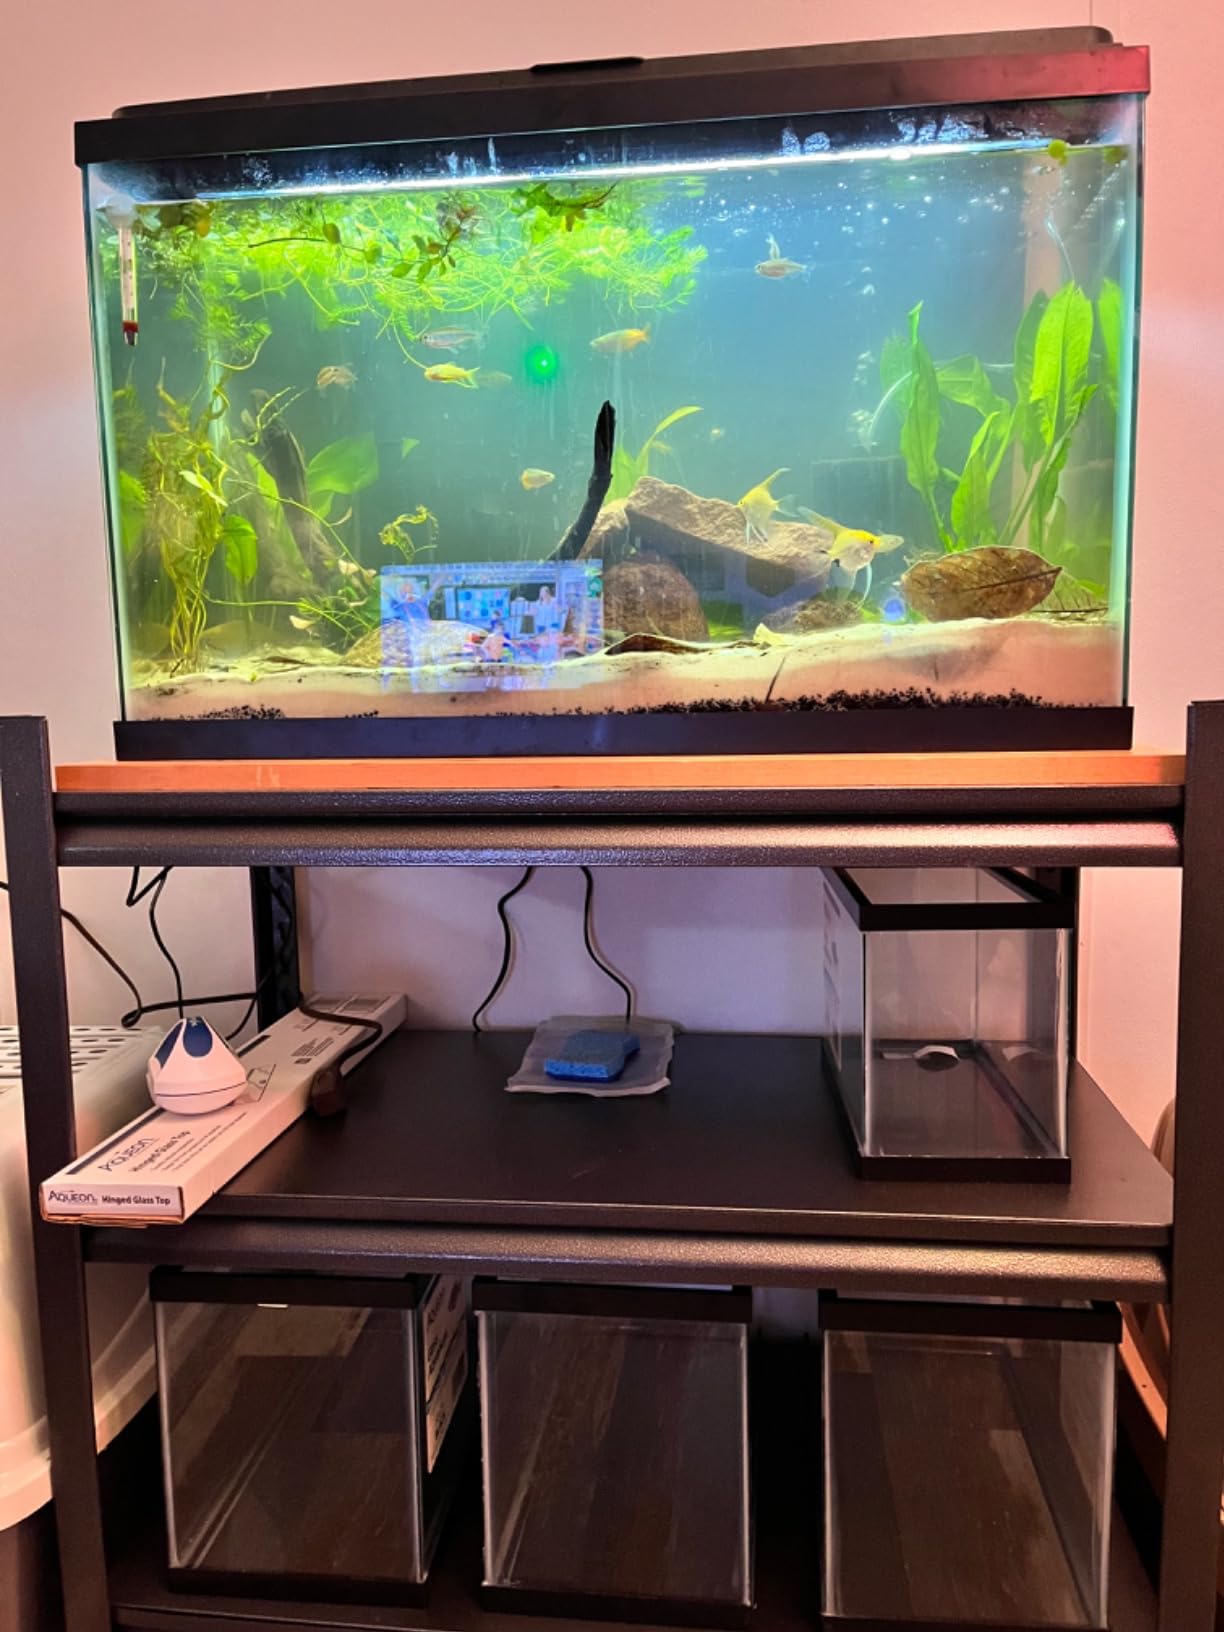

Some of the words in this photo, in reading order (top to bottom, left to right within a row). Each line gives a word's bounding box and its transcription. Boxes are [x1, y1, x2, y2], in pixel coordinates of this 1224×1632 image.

[102, 1196, 131, 1205] Hinged
[133, 1196, 154, 1205] Glass
[156, 1197, 171, 1205] Top
